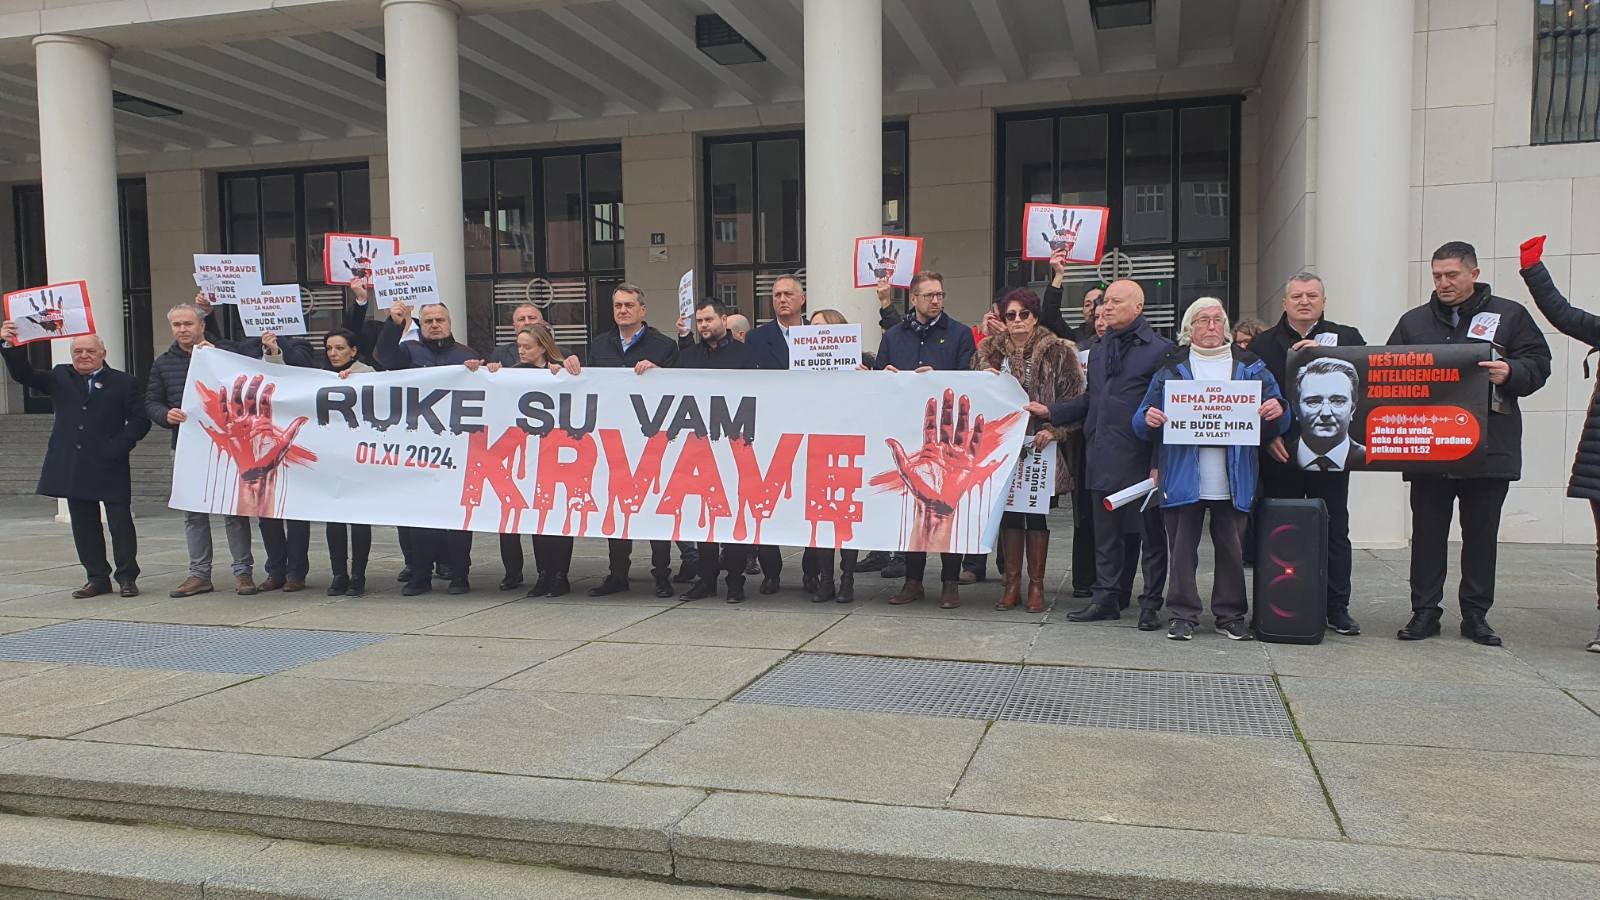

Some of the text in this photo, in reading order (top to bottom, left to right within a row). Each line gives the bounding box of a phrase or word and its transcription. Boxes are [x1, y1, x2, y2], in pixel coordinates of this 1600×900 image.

[375, 264, 431, 276] NEMA PRAVDE
[389, 287, 408, 296] BUDE
[411, 286, 433, 294] MIRA
[264, 296, 296, 304] PRAVDE
[794, 337, 818, 345] NEMA
[1368, 352, 1434, 366] VEŠTAČKA
[1368, 368, 1460, 382] INTELIGENCIJA
[1367, 385, 1430, 398] ZOBENICA
[1172, 395, 1255, 404] NEMA PRAVDE
[316, 385, 756, 446] RUKE SU VAM
[1171, 421, 1253, 430] NE BUDE MIRA
[356, 442, 457, 469] 01.XI 2024.
[460, 426, 866, 540] KRVAVE
[1017, 481, 1022, 489] ZA
[1031, 468, 1040, 492] BUDE
[1040, 481, 1046, 489] ZA
[1029, 495, 1037, 507] NE
